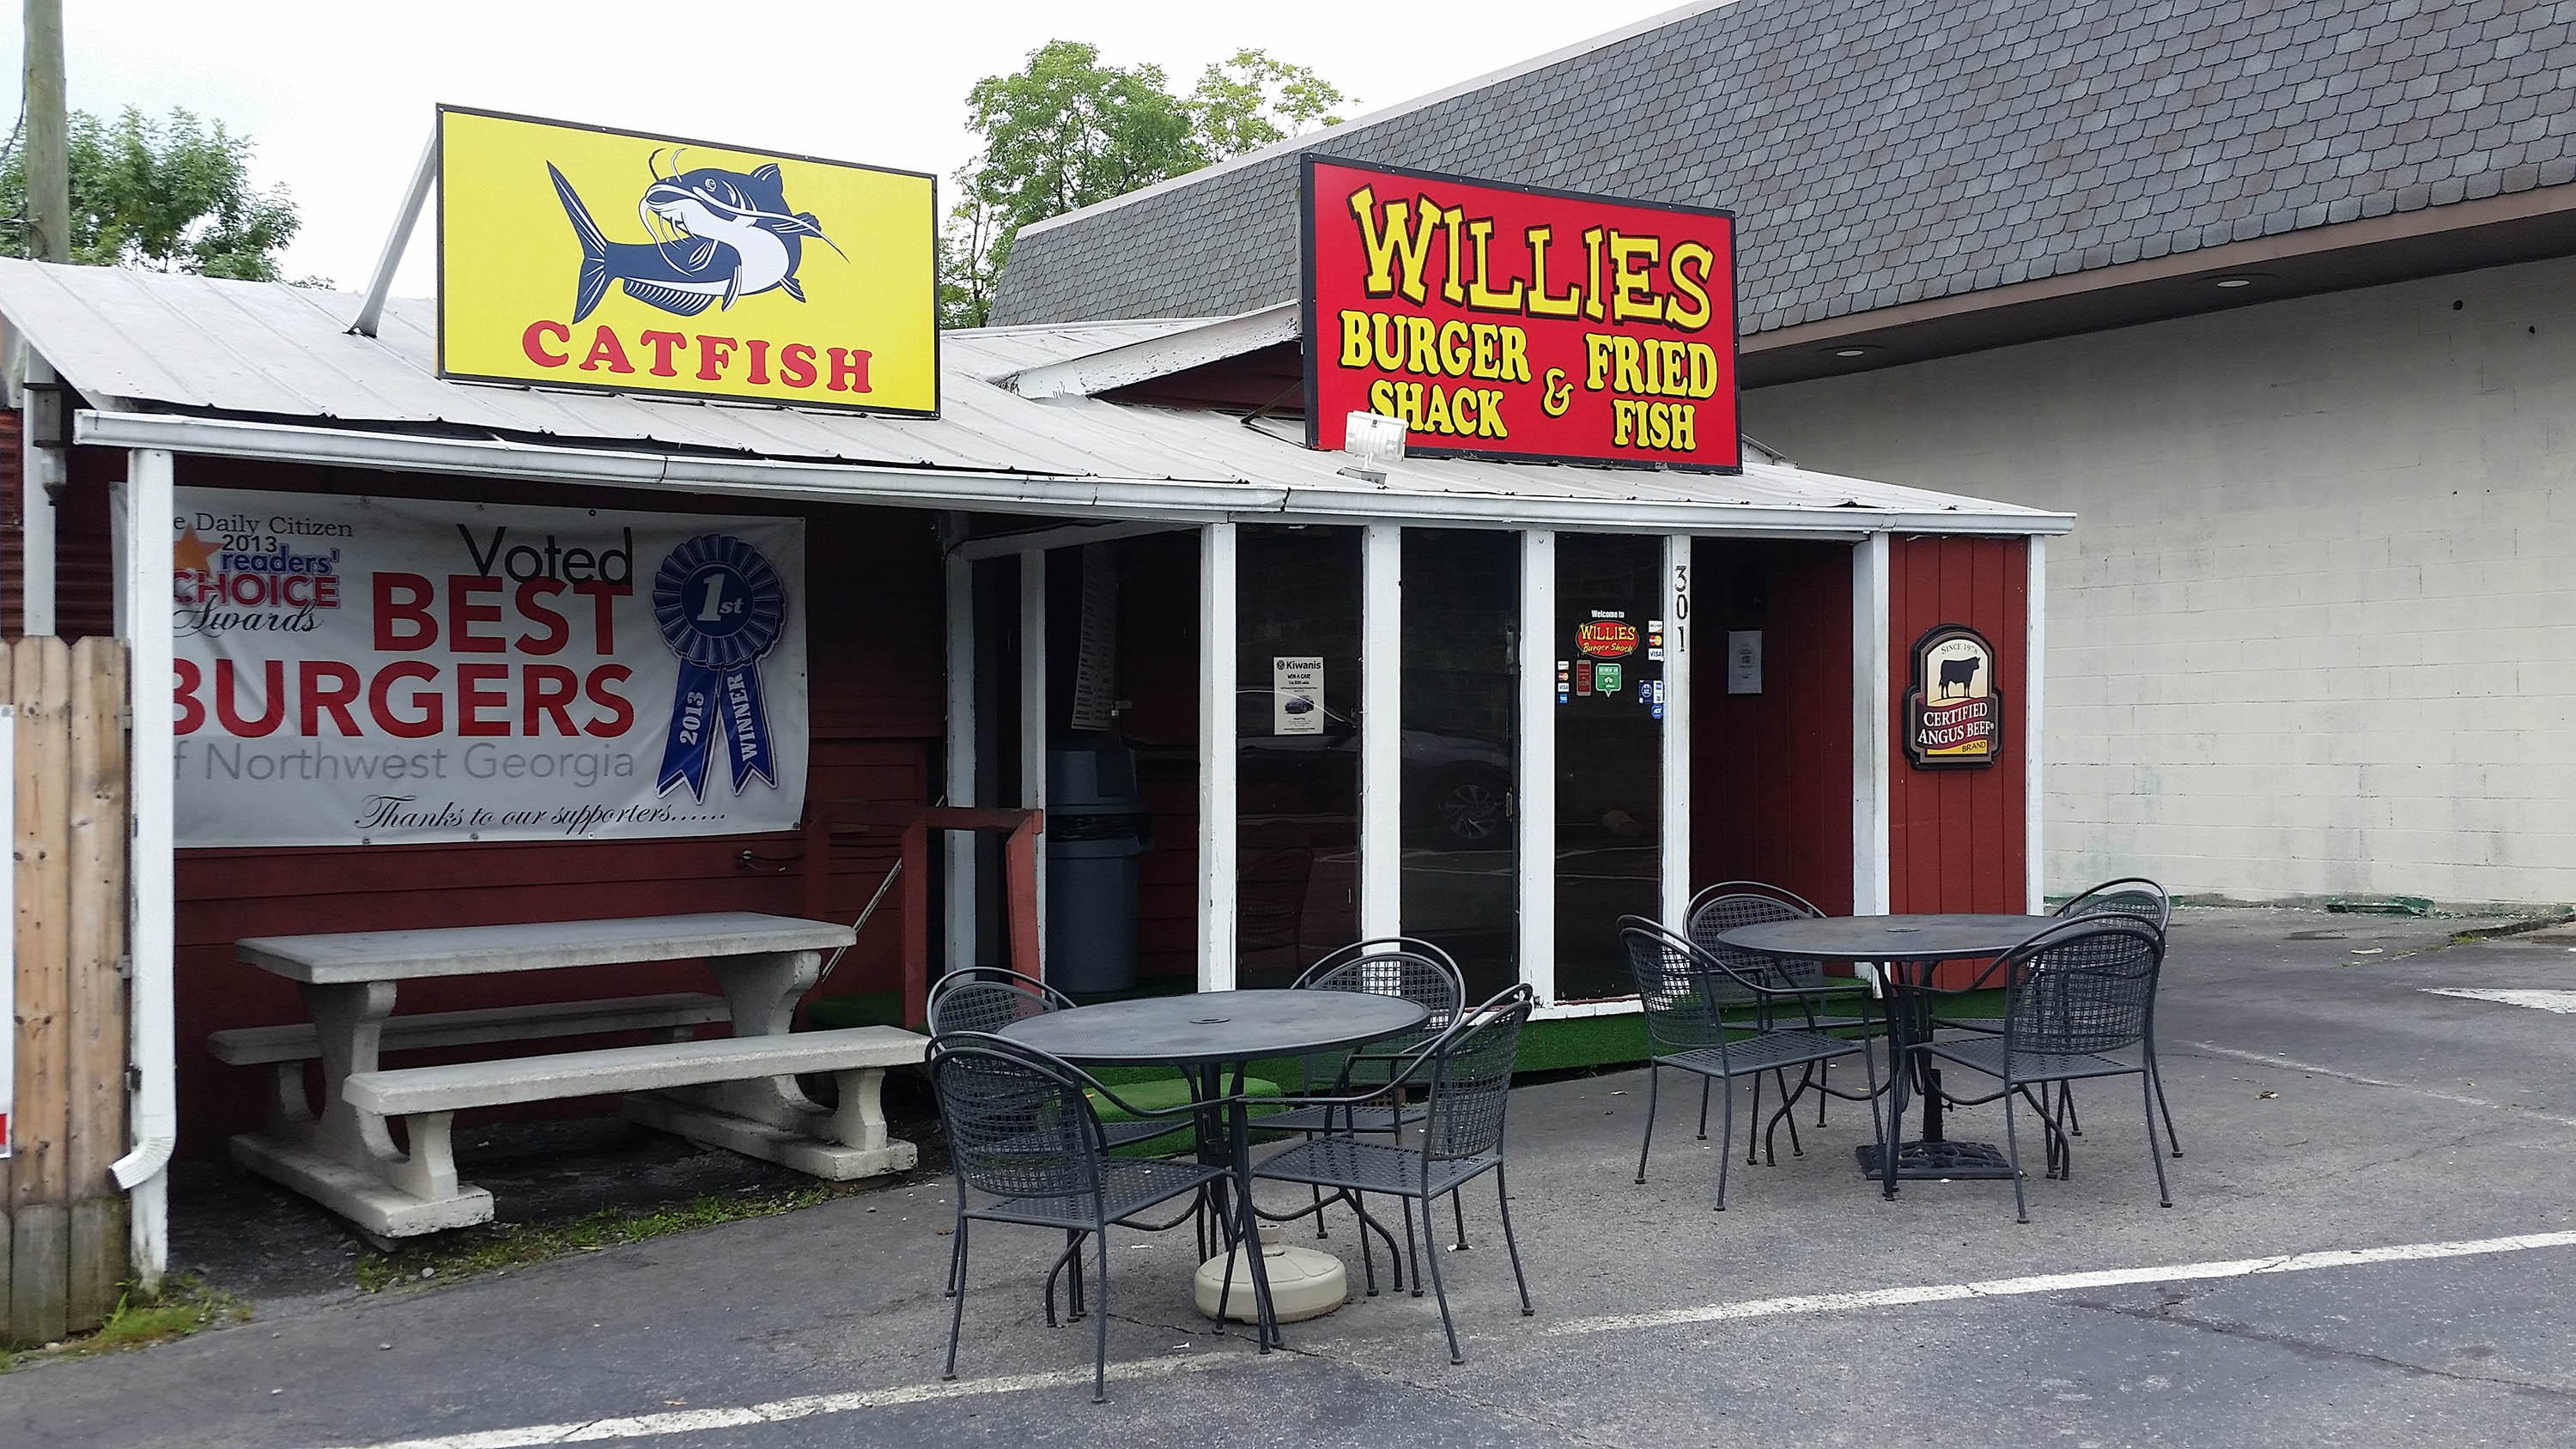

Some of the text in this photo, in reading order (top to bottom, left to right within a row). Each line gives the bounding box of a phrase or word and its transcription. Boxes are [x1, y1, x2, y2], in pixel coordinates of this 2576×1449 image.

[1347, 183, 1716, 331] WILLIES
[522, 319, 872, 393] CATFISH
[1339, 309, 1532, 383] BURGER
[1584, 333, 1718, 399] FRIED
[1369, 379, 1509, 439] SHACK
[1542, 368, 1574, 417] &
[1612, 399, 1696, 451] FISH
[195, 512, 260, 537] Daily
[269, 516, 354, 537] Citizen
[222, 534, 277, 553] 2013
[221, 543, 340, 573] readers'
[456, 524, 633, 585] Voted
[173, 570, 340, 608] CHOICE
[697, 573, 744, 621] 1st
[173, 594, 325, 638] Awards
[373, 572, 633, 655] BEST
[1580, 623, 1636, 640] WILLIES
[1286, 660, 1321, 670] Kiwanis
[1583, 642, 1633, 654] Burger Shack
[1941, 643, 1961, 654] SINCE
[173, 658, 634, 738] BURGERS
[679, 691, 704, 746] 2013
[726, 673, 757, 761] WINNER
[1923, 702, 1988, 726] CERTIFIED
[1917, 725, 1964, 745] ANGUS
[1962, 741, 1986, 752] BRAND
[173, 740, 634, 788] f Northwest Georgia
[355, 795, 463, 828] Thanks
[470, 805, 495, 826] to
[501, 809, 544, 826] our
